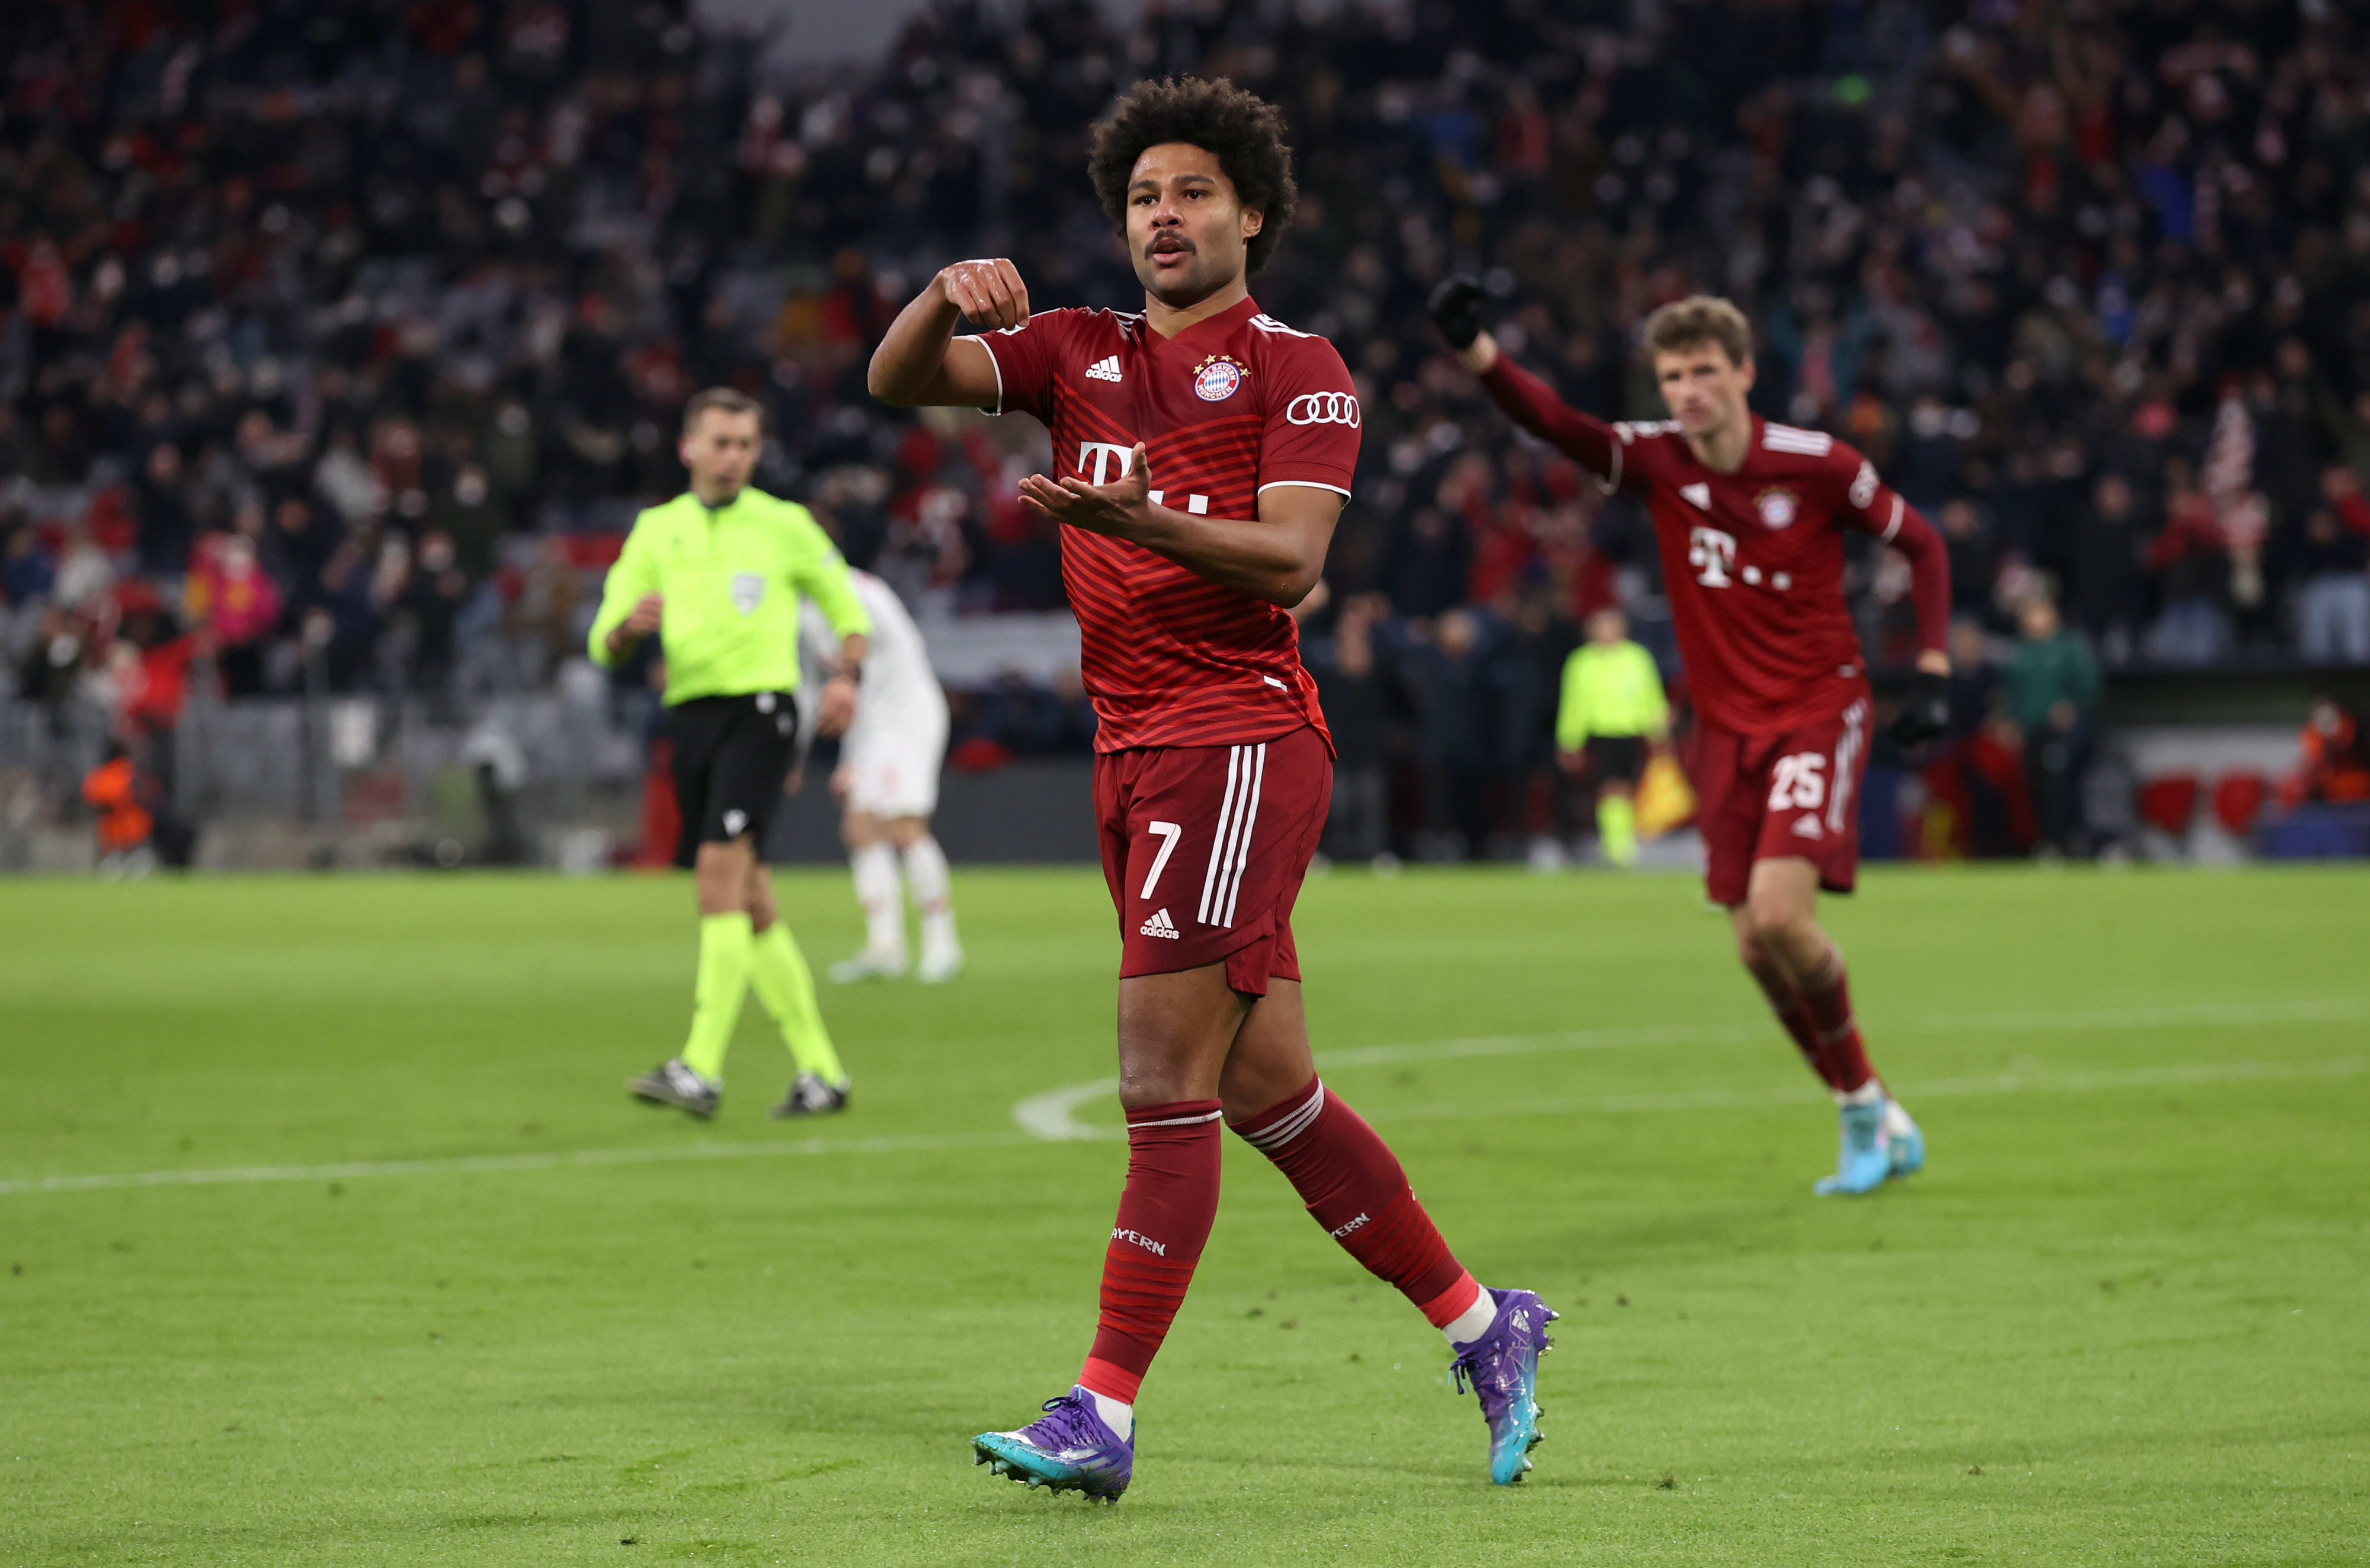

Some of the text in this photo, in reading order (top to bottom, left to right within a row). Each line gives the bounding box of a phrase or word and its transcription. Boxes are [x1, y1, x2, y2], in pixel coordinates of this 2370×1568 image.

[1085, 368, 1123, 383] adidas
[1201, 365, 1237, 381] FC BAYERN
[1767, 751, 1827, 812] 25
[1140, 821, 1181, 900] 7
[1140, 925, 1180, 939] adidas
[1327, 1212, 1370, 1239] YERN
[1110, 1227, 1166, 1256] AYERN
